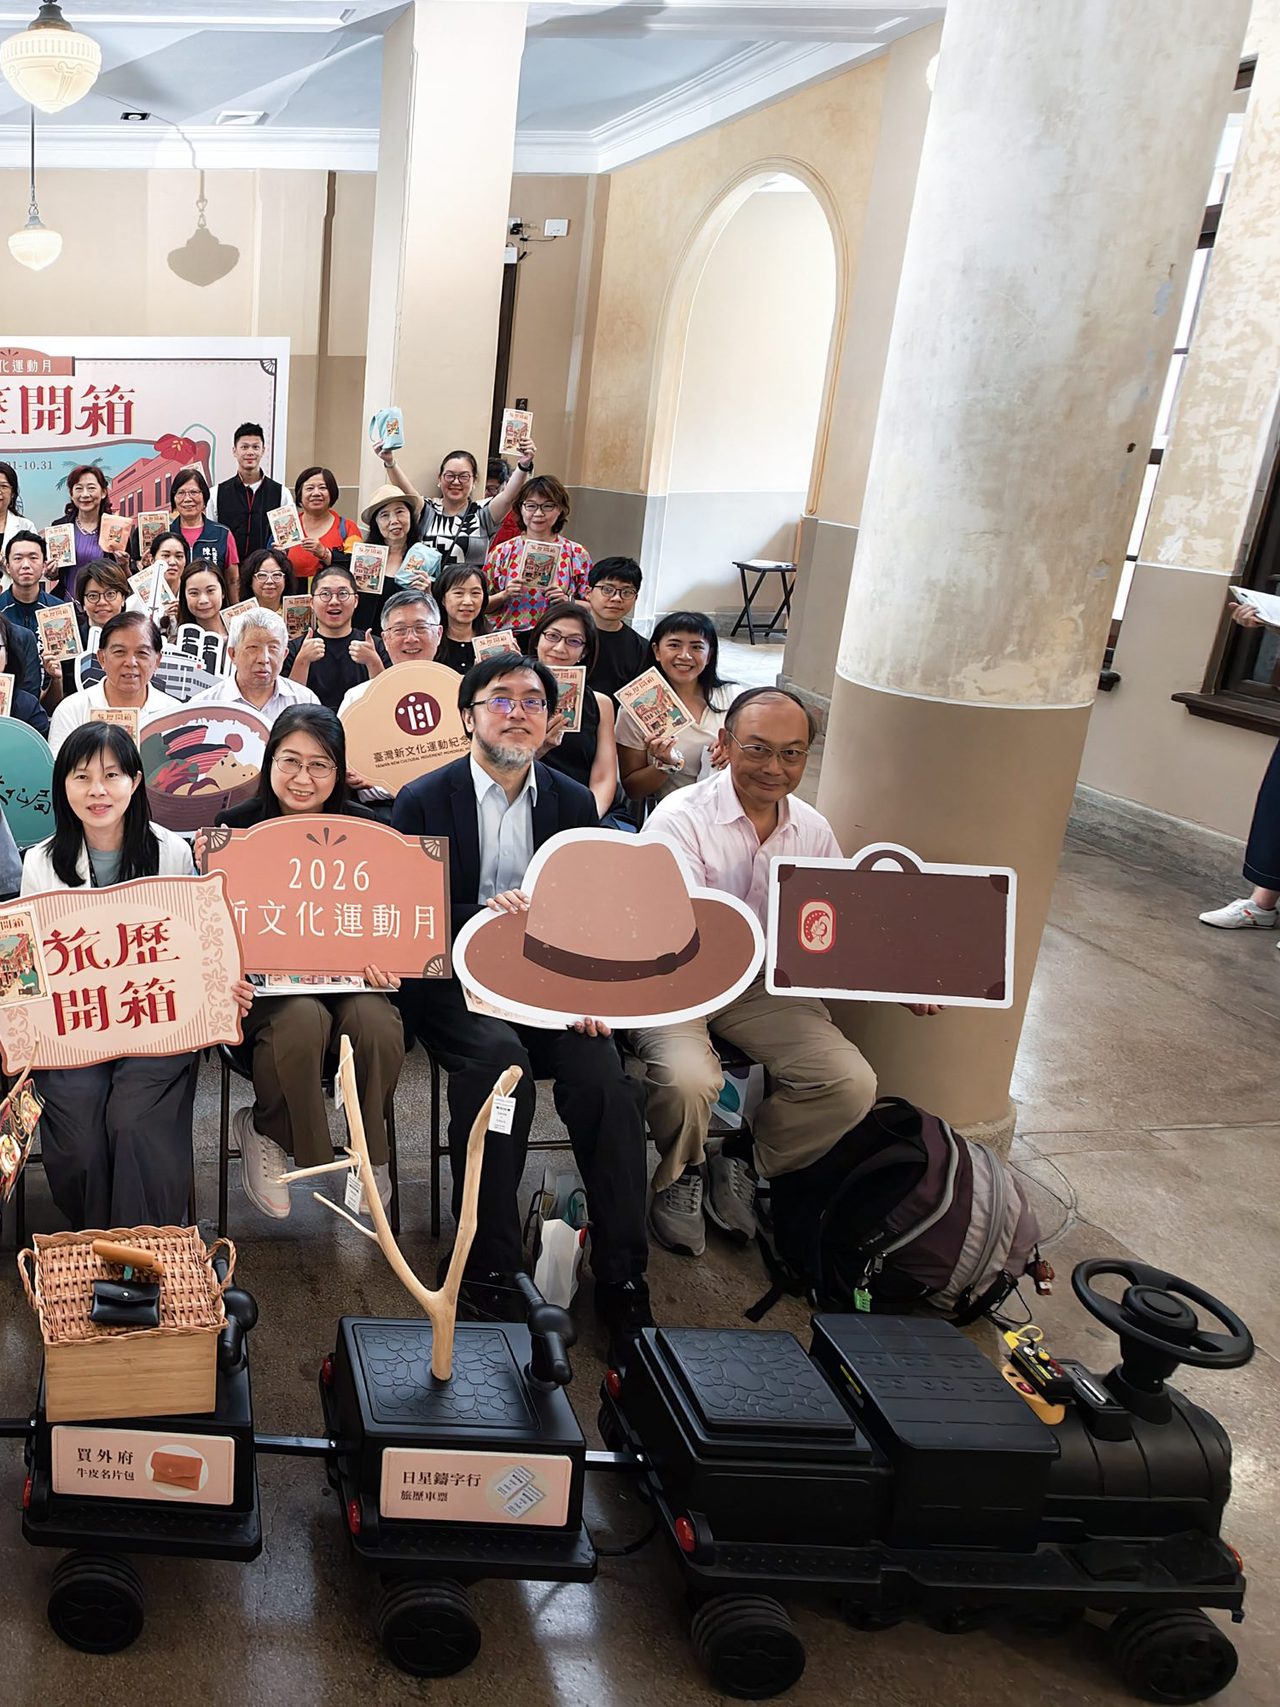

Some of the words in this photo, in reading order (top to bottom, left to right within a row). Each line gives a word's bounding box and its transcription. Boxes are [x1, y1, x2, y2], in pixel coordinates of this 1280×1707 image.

[288, 857, 370, 891] 2026
[45, 914, 180, 972] 旅歷
[52, 977, 178, 1037] 開箱
[77, 1448, 134, 1465] 買外府
[77, 1467, 135, 1481] 牛皮名片包
[402, 1471, 482, 1487] 日星鑄字行
